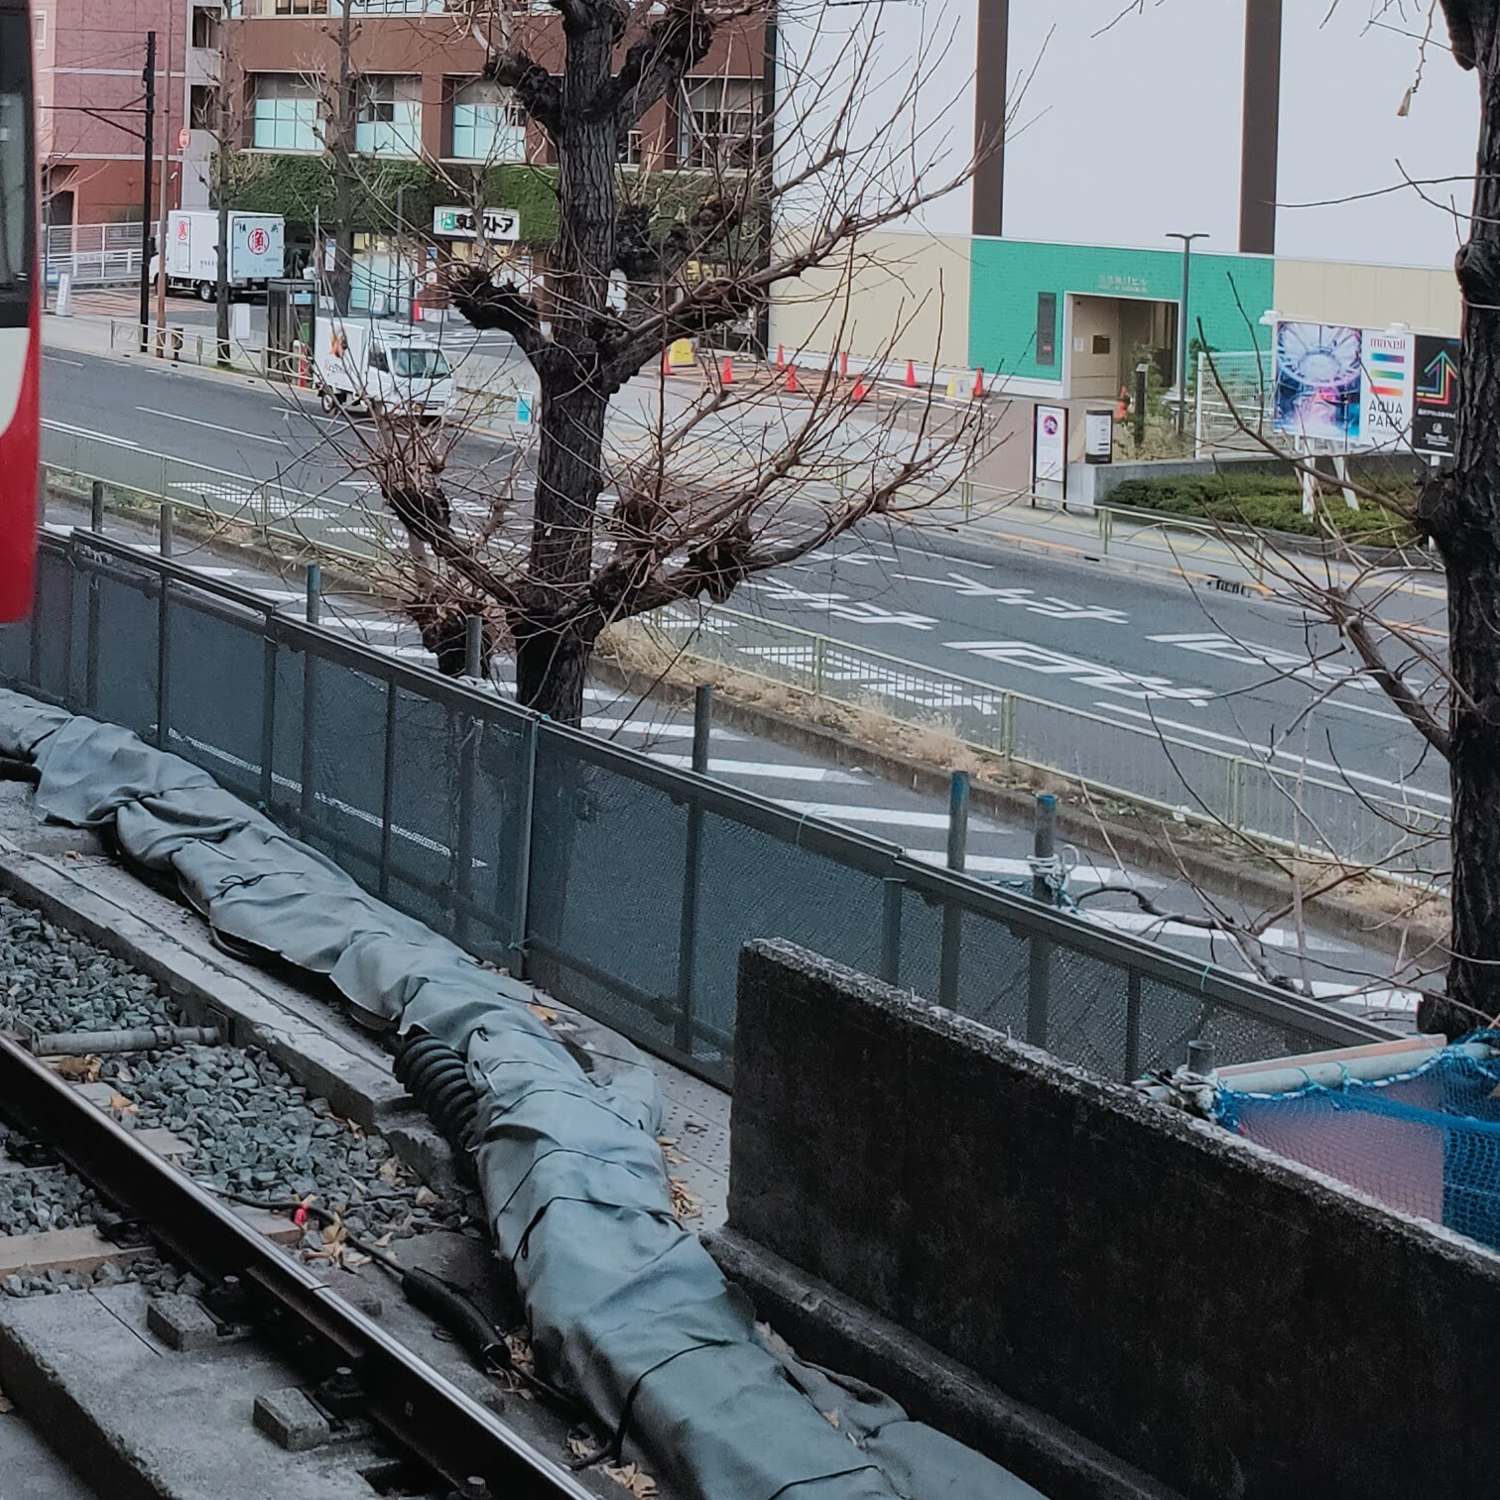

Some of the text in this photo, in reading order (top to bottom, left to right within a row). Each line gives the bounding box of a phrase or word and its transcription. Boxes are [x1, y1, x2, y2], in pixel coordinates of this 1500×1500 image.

[1370, 338, 1406, 350] maxell
[1369, 400, 1404, 415] AQUA
[1368, 413, 1403, 430] PARK
